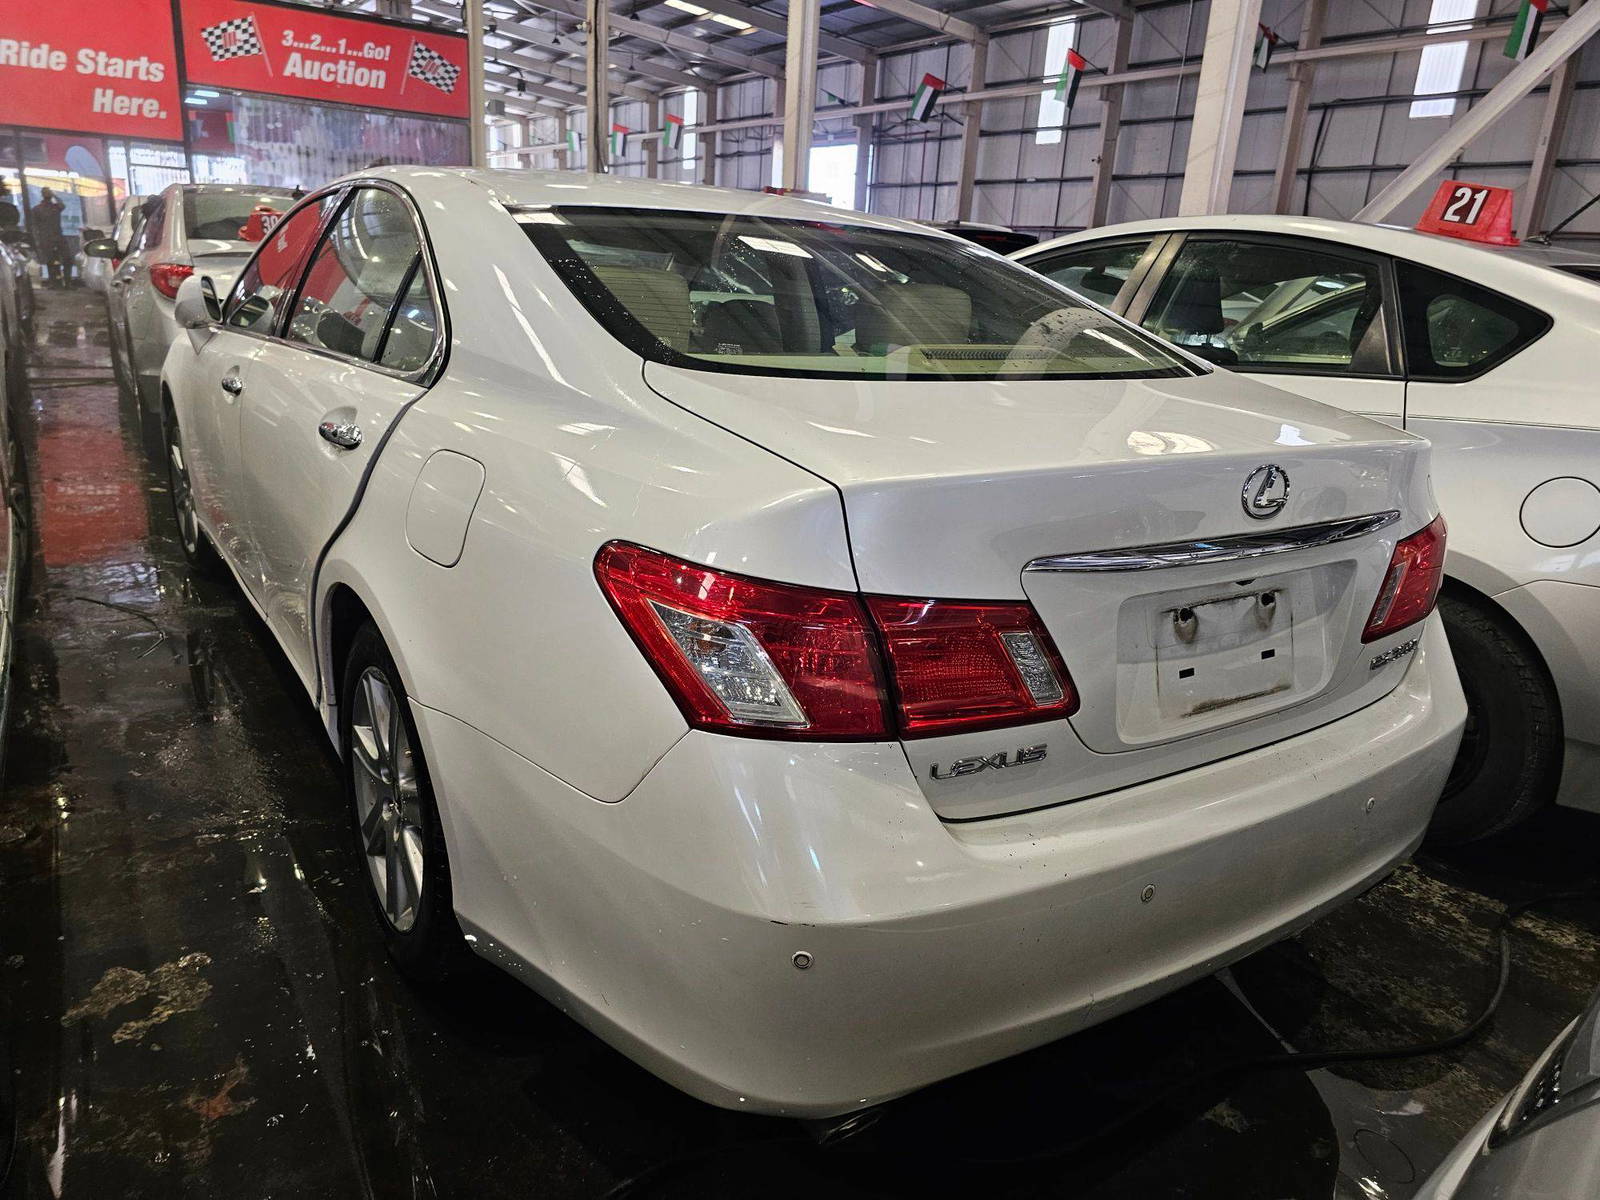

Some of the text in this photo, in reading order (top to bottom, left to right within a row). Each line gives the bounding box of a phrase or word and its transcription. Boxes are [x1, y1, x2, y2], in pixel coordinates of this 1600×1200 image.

[0, 38, 165, 82] Ride Starts
[283, 52, 386, 89] Auction
[92, 87, 167, 119] Here.
[1443, 186, 1488, 224] 21
[930, 743, 1048, 780] LEXUS
